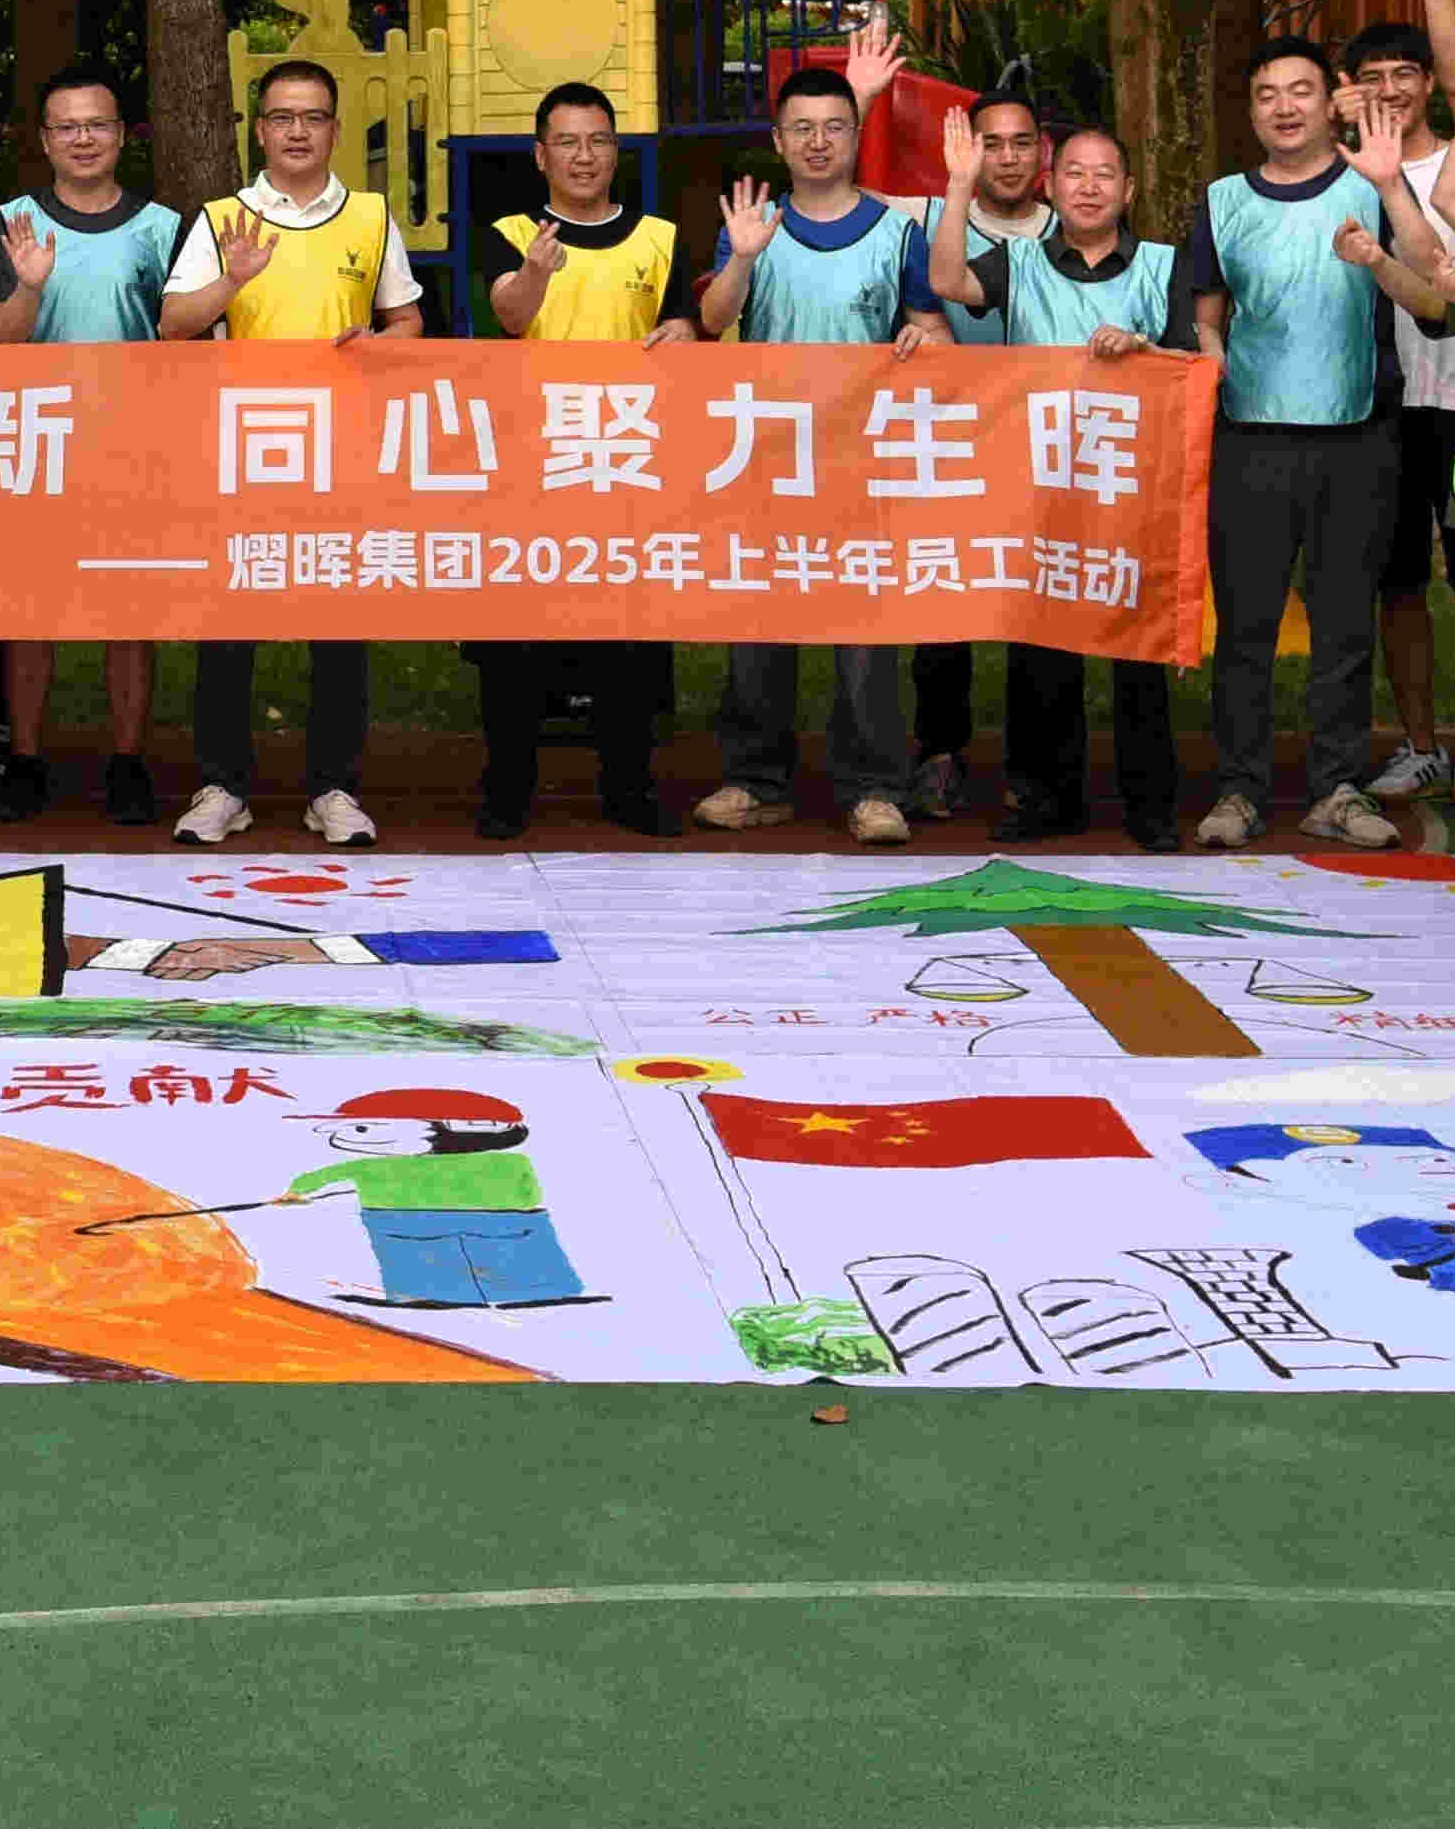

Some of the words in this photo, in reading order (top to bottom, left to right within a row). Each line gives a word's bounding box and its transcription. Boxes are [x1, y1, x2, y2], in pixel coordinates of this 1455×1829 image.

[216, 377, 1142, 507] 同心聚力生晖
